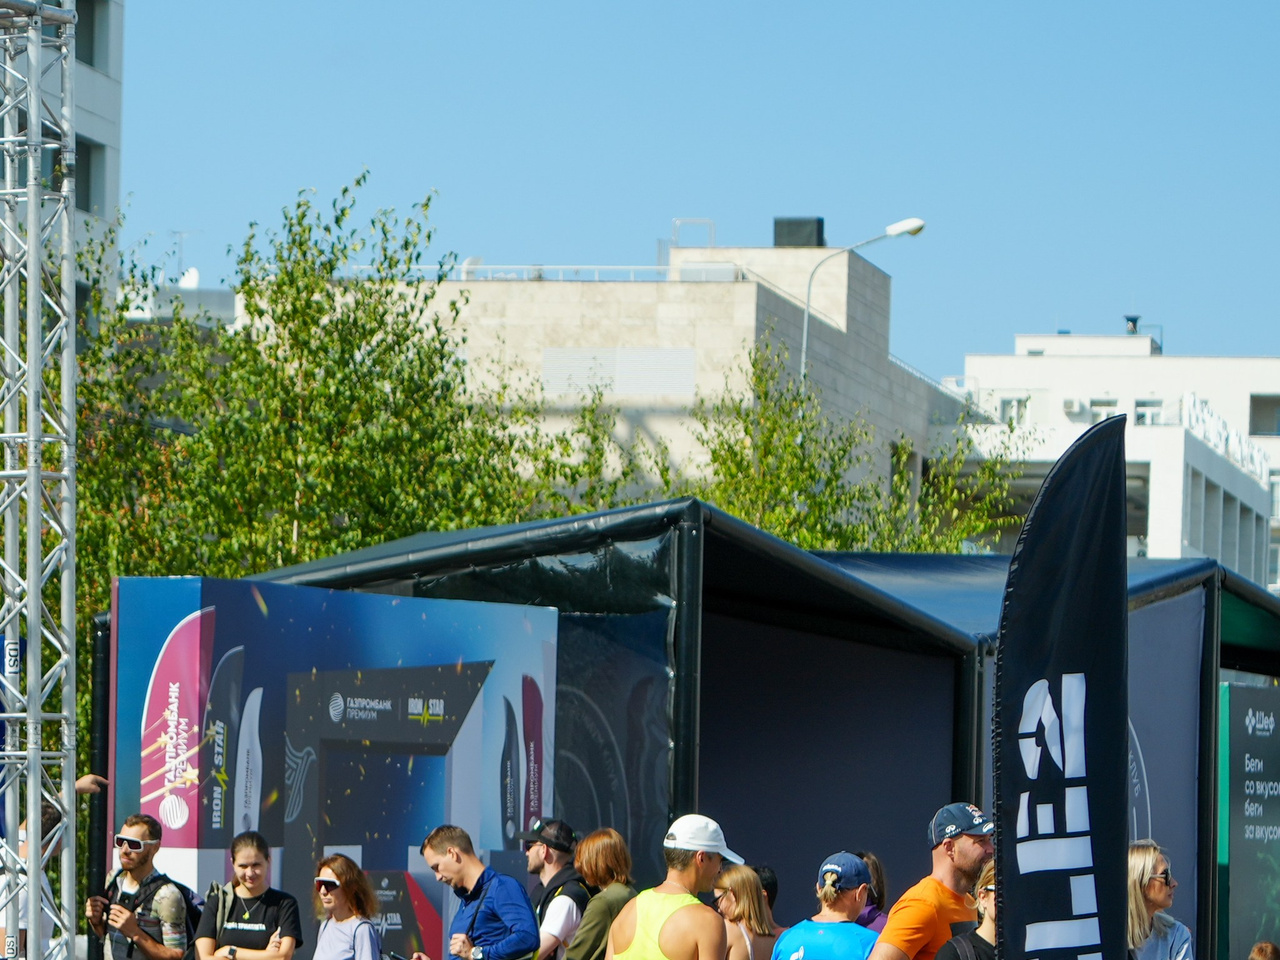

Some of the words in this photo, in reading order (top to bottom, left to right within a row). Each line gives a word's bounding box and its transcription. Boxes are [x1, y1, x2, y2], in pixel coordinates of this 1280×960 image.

[346, 697, 392, 710] ГАЗПРОМБАНК
[408, 698, 423, 714] IRON
[428, 699, 445, 714] STAR
[346, 708, 377, 719] ПРЕМИУМ
[1256, 710, 1275, 734] Шеф
[164, 681, 180, 787] ГАЗПРОМБАНК
[214, 719, 225, 767] STAR
[1245, 753, 1263, 772] Беги
[1245, 780, 1254, 794] со
[212, 786, 222, 829] IRON
[1245, 800, 1263, 817] беги
[1245, 825, 1254, 839] за
[386, 912, 402, 924] STAR
